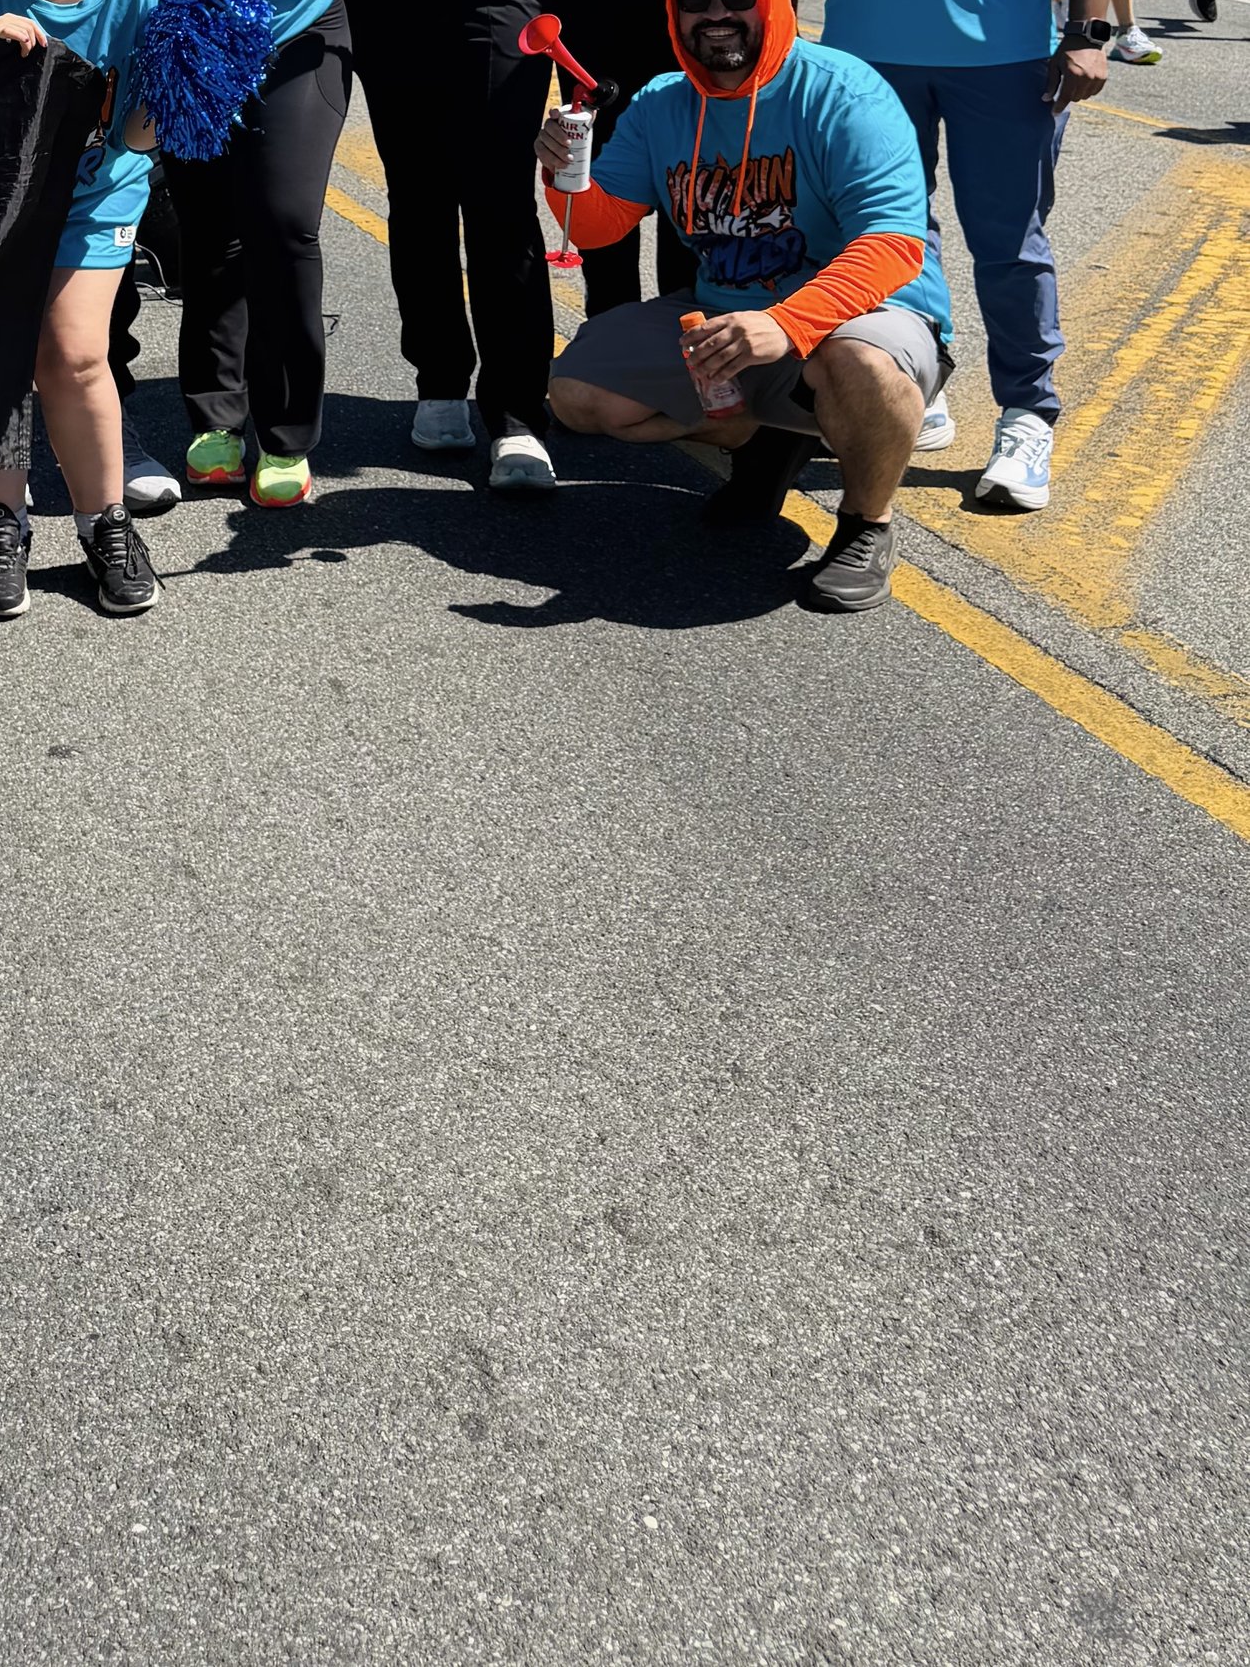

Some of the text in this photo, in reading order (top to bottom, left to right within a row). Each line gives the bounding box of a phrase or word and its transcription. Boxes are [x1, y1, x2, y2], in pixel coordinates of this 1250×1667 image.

[559, 121, 579, 131] AIR
[728, 148, 793, 214] RUN
[708, 209, 750, 237] WE
